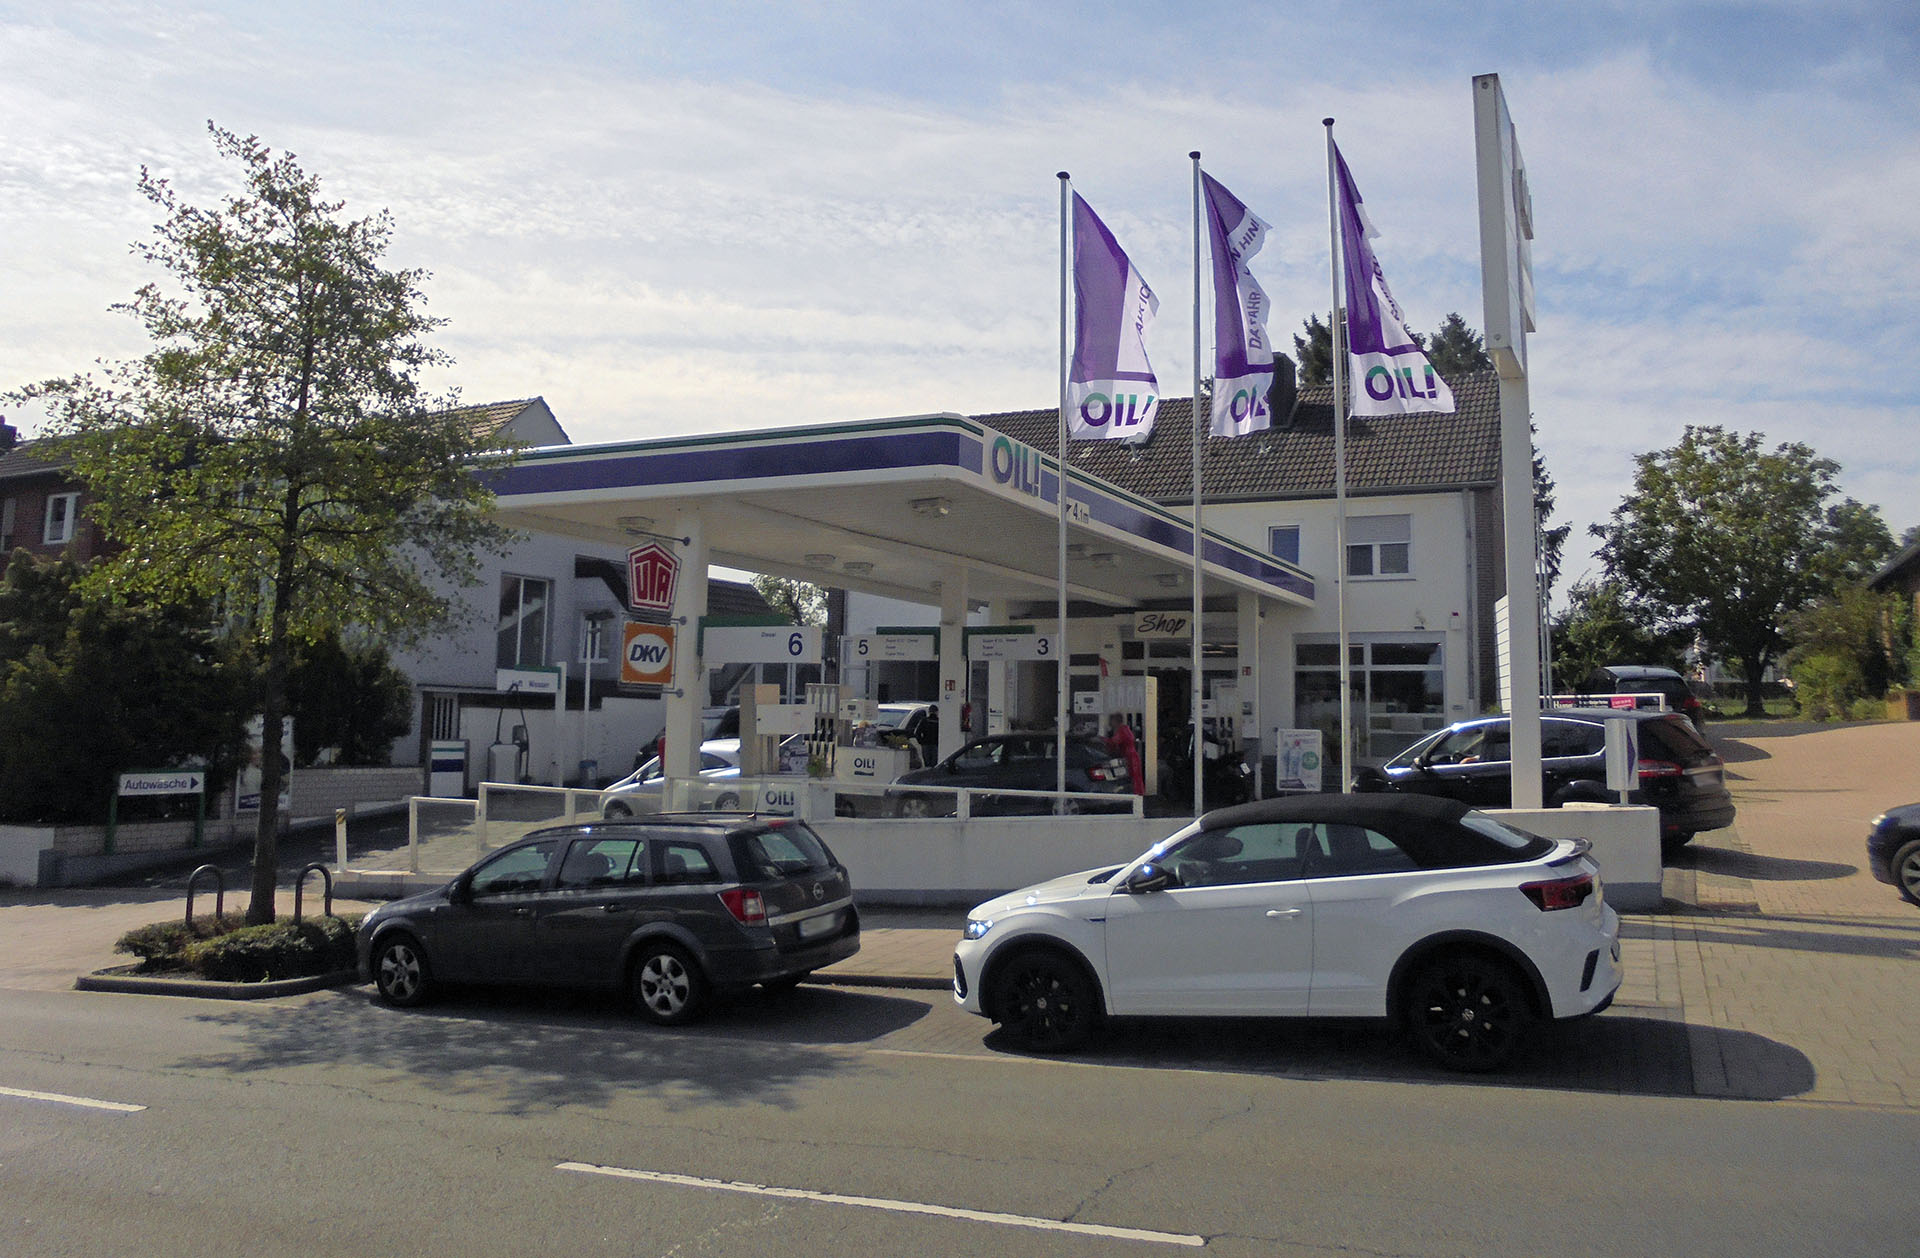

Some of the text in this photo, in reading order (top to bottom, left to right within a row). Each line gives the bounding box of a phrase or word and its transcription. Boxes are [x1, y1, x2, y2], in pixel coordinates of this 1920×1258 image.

[1364, 364, 1437, 401] OIL!
[1080, 391, 1155, 427] OIL!
[992, 435, 1040, 497] OIL!
[634, 550, 673, 603] UTA
[1137, 613, 1186, 636] Shop
[629, 644, 668, 664] DKV
[788, 632, 803, 656] 6
[858, 639, 869, 655] 5
[1036, 638, 1049, 655] 3
[854, 757, 875, 769] OIL!
[124, 778, 188, 790] Autowäsche
[765, 790, 795, 806] OIL!
